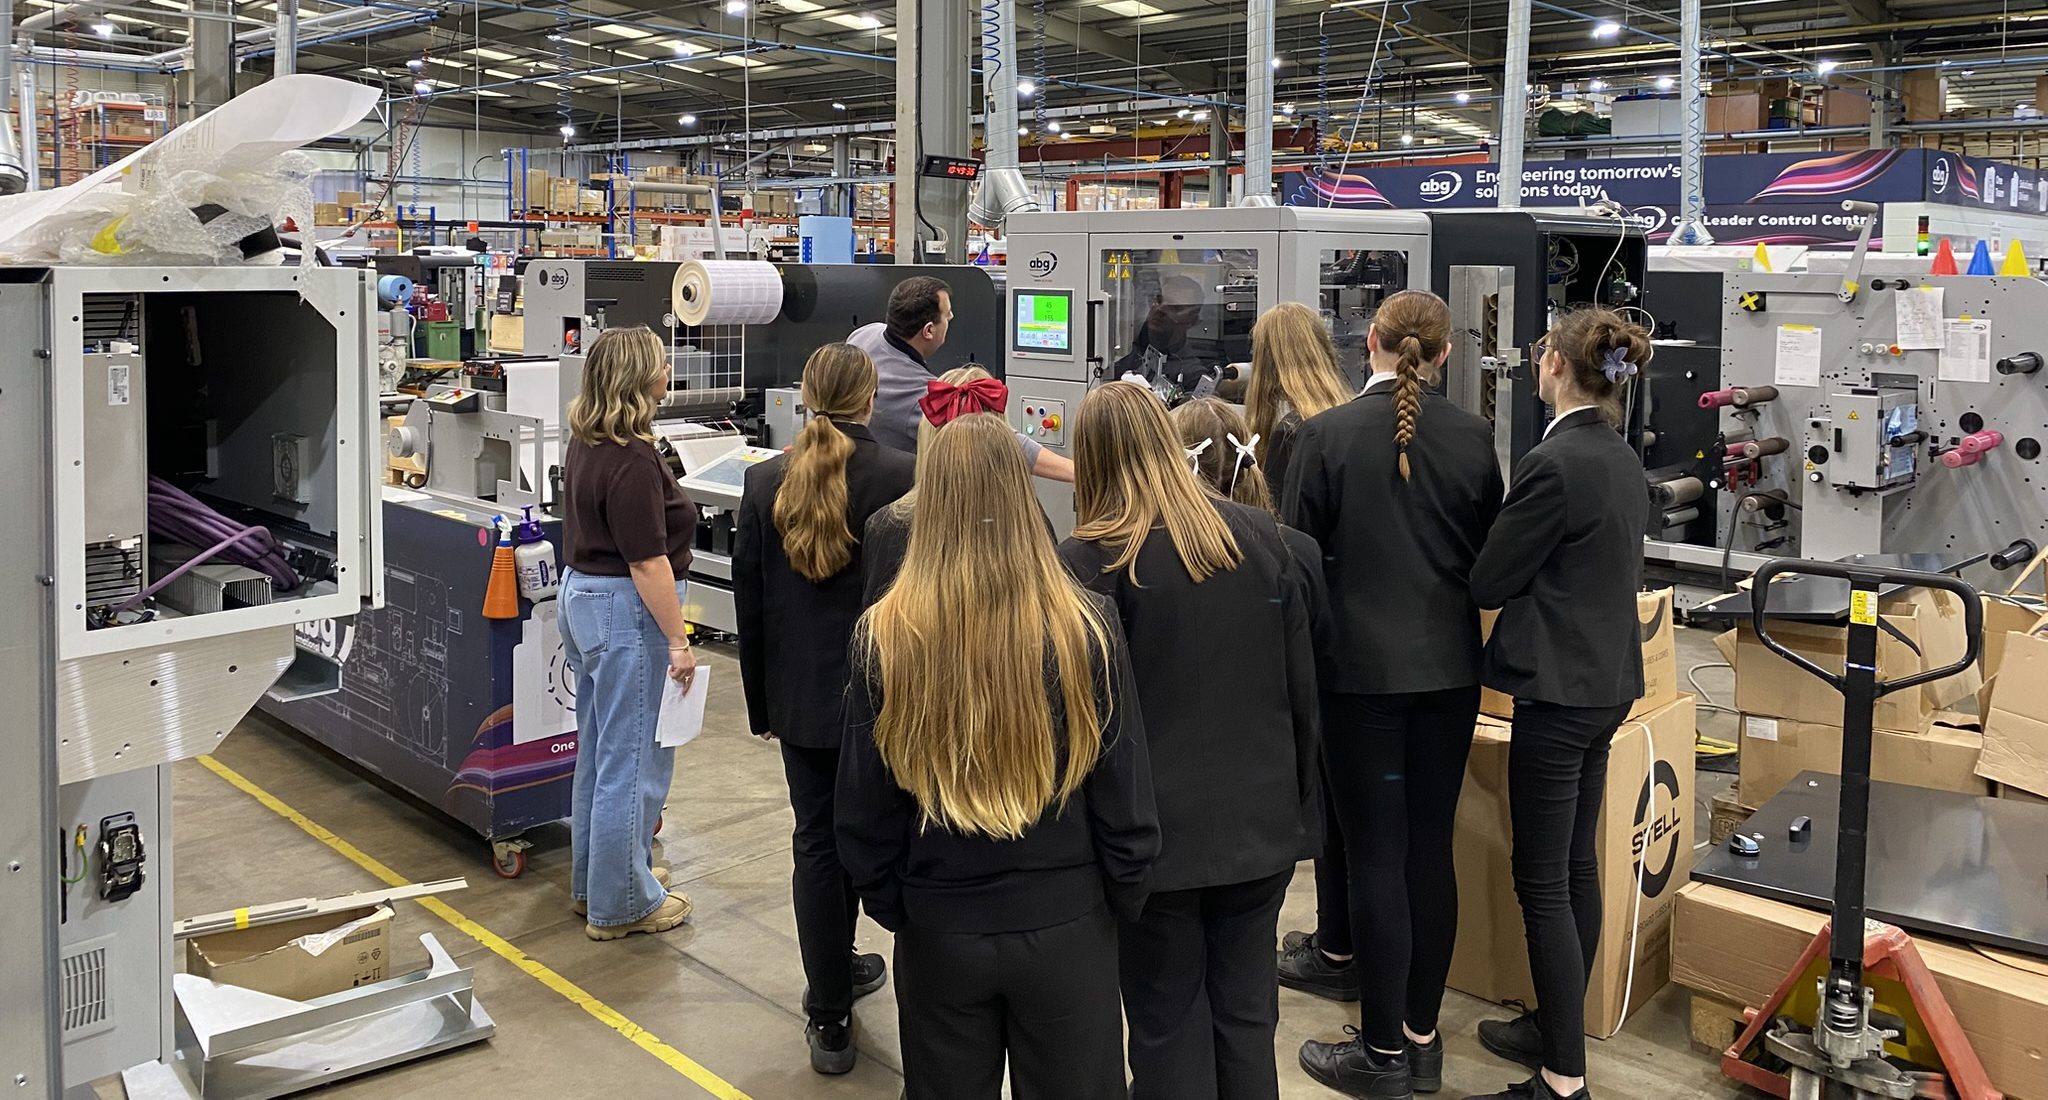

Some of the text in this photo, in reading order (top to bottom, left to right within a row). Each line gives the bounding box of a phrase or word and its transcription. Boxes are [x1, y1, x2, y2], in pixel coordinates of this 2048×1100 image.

[1476, 163, 1682, 184] Eneering tomorrow's
[1475, 184, 1549, 198] solons
[1703, 214, 1754, 226] Leader
[1758, 214, 1817, 226] Control
[551, 741, 575, 753] One
[1631, 807, 1681, 855] STELL
